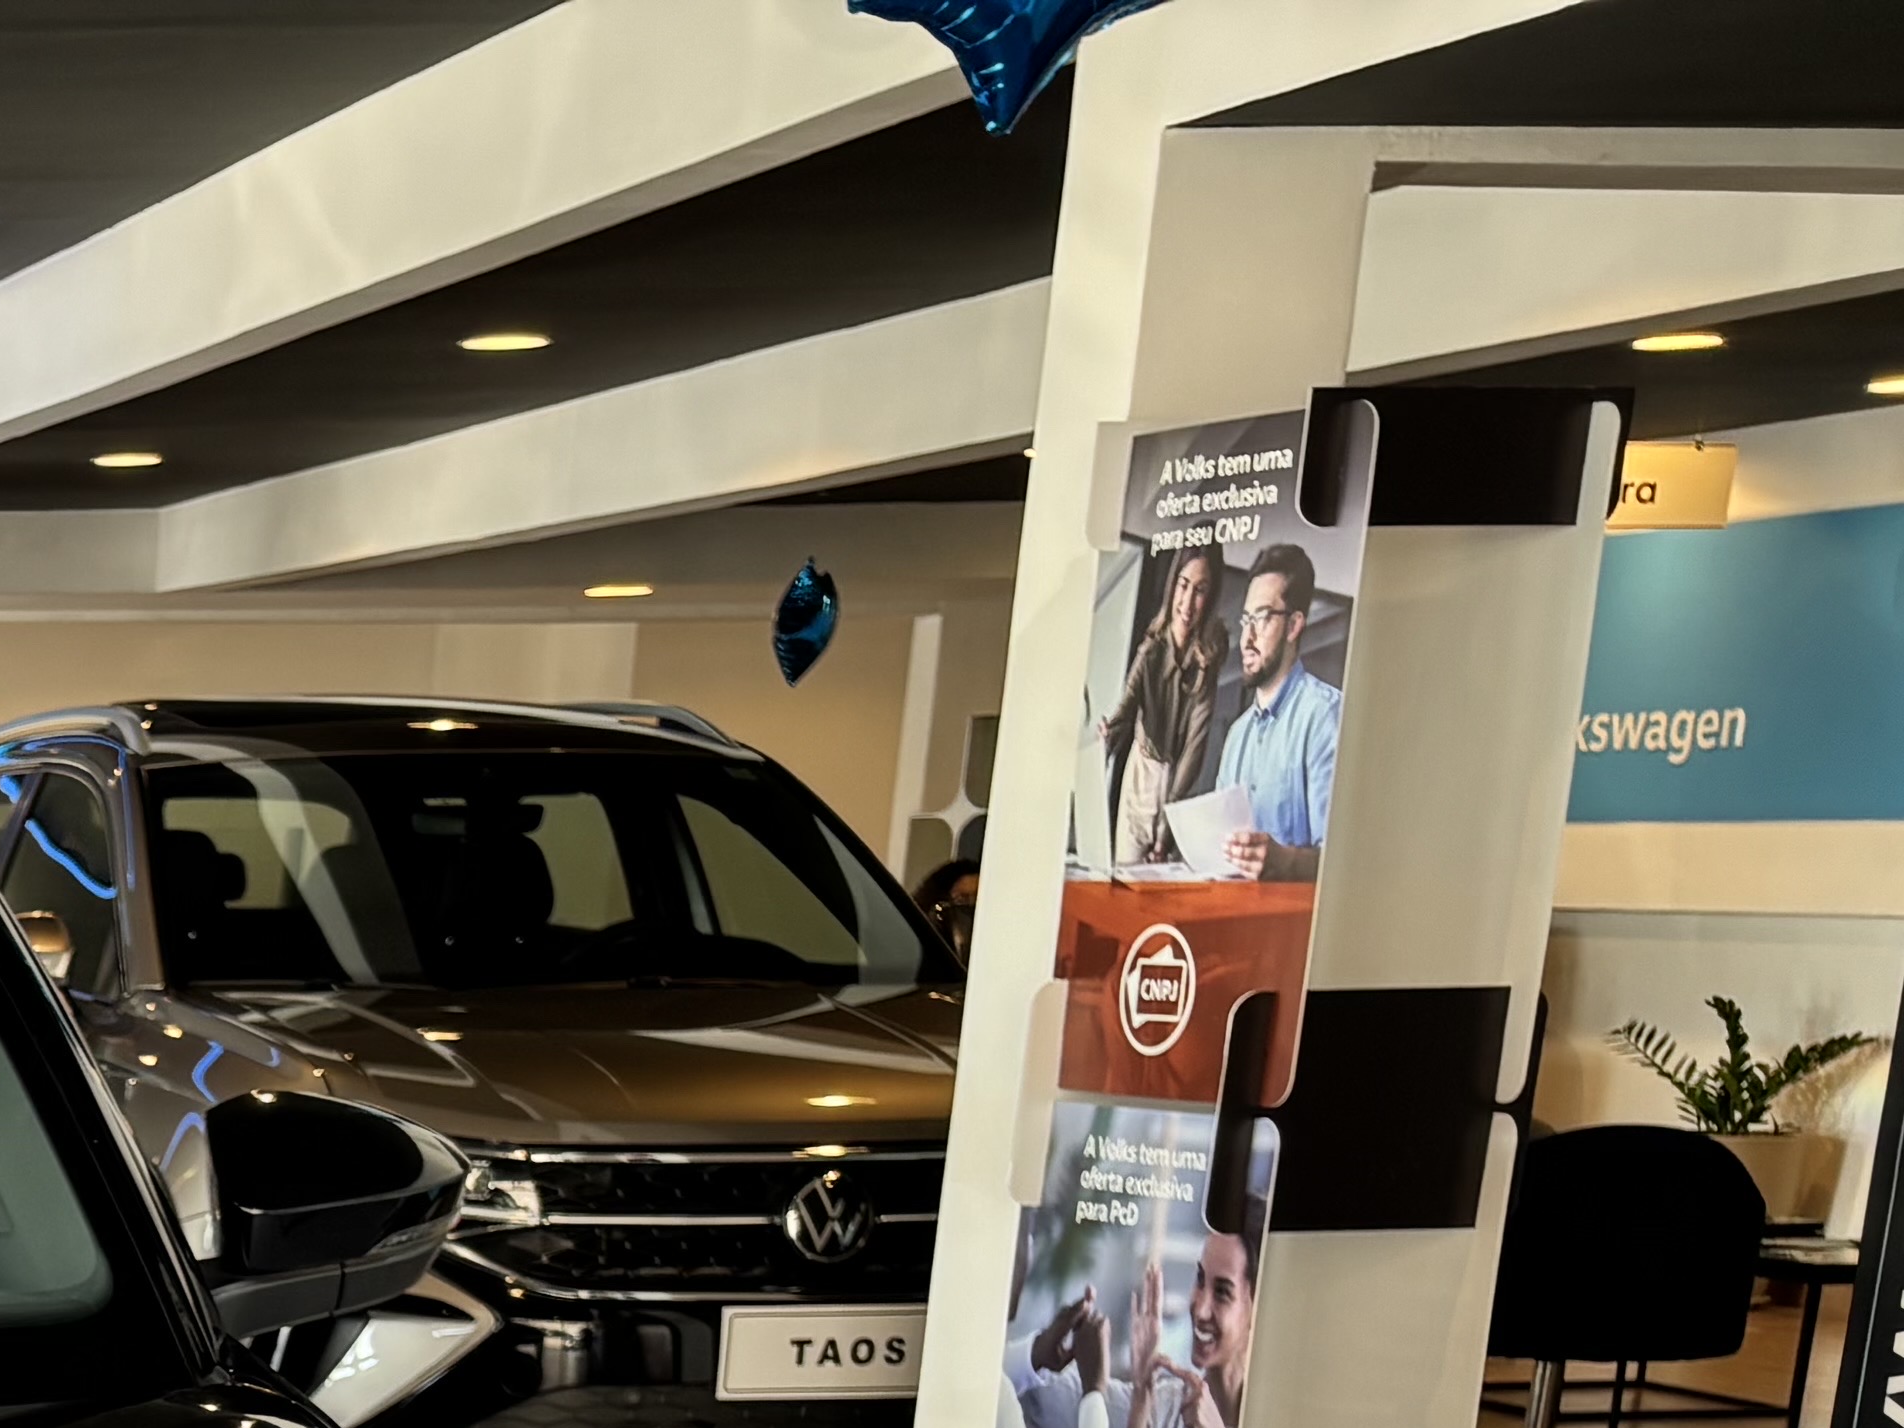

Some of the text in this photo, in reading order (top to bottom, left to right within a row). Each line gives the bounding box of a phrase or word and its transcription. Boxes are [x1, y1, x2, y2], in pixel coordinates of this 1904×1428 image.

[1159, 448, 1293, 486] A Volks tem uma
[1156, 480, 1279, 519] oferta exclusiva
[1150, 514, 1261, 557] para seu CNPJ
[1141, 978, 1179, 1002] CNPJ
[1083, 1134, 1207, 1172] A Volks tem uma
[1080, 1165, 1194, 1202] oferta exclusiva
[1075, 1199, 1140, 1226] para PcD
[790, 1336, 907, 1367] TAOS
